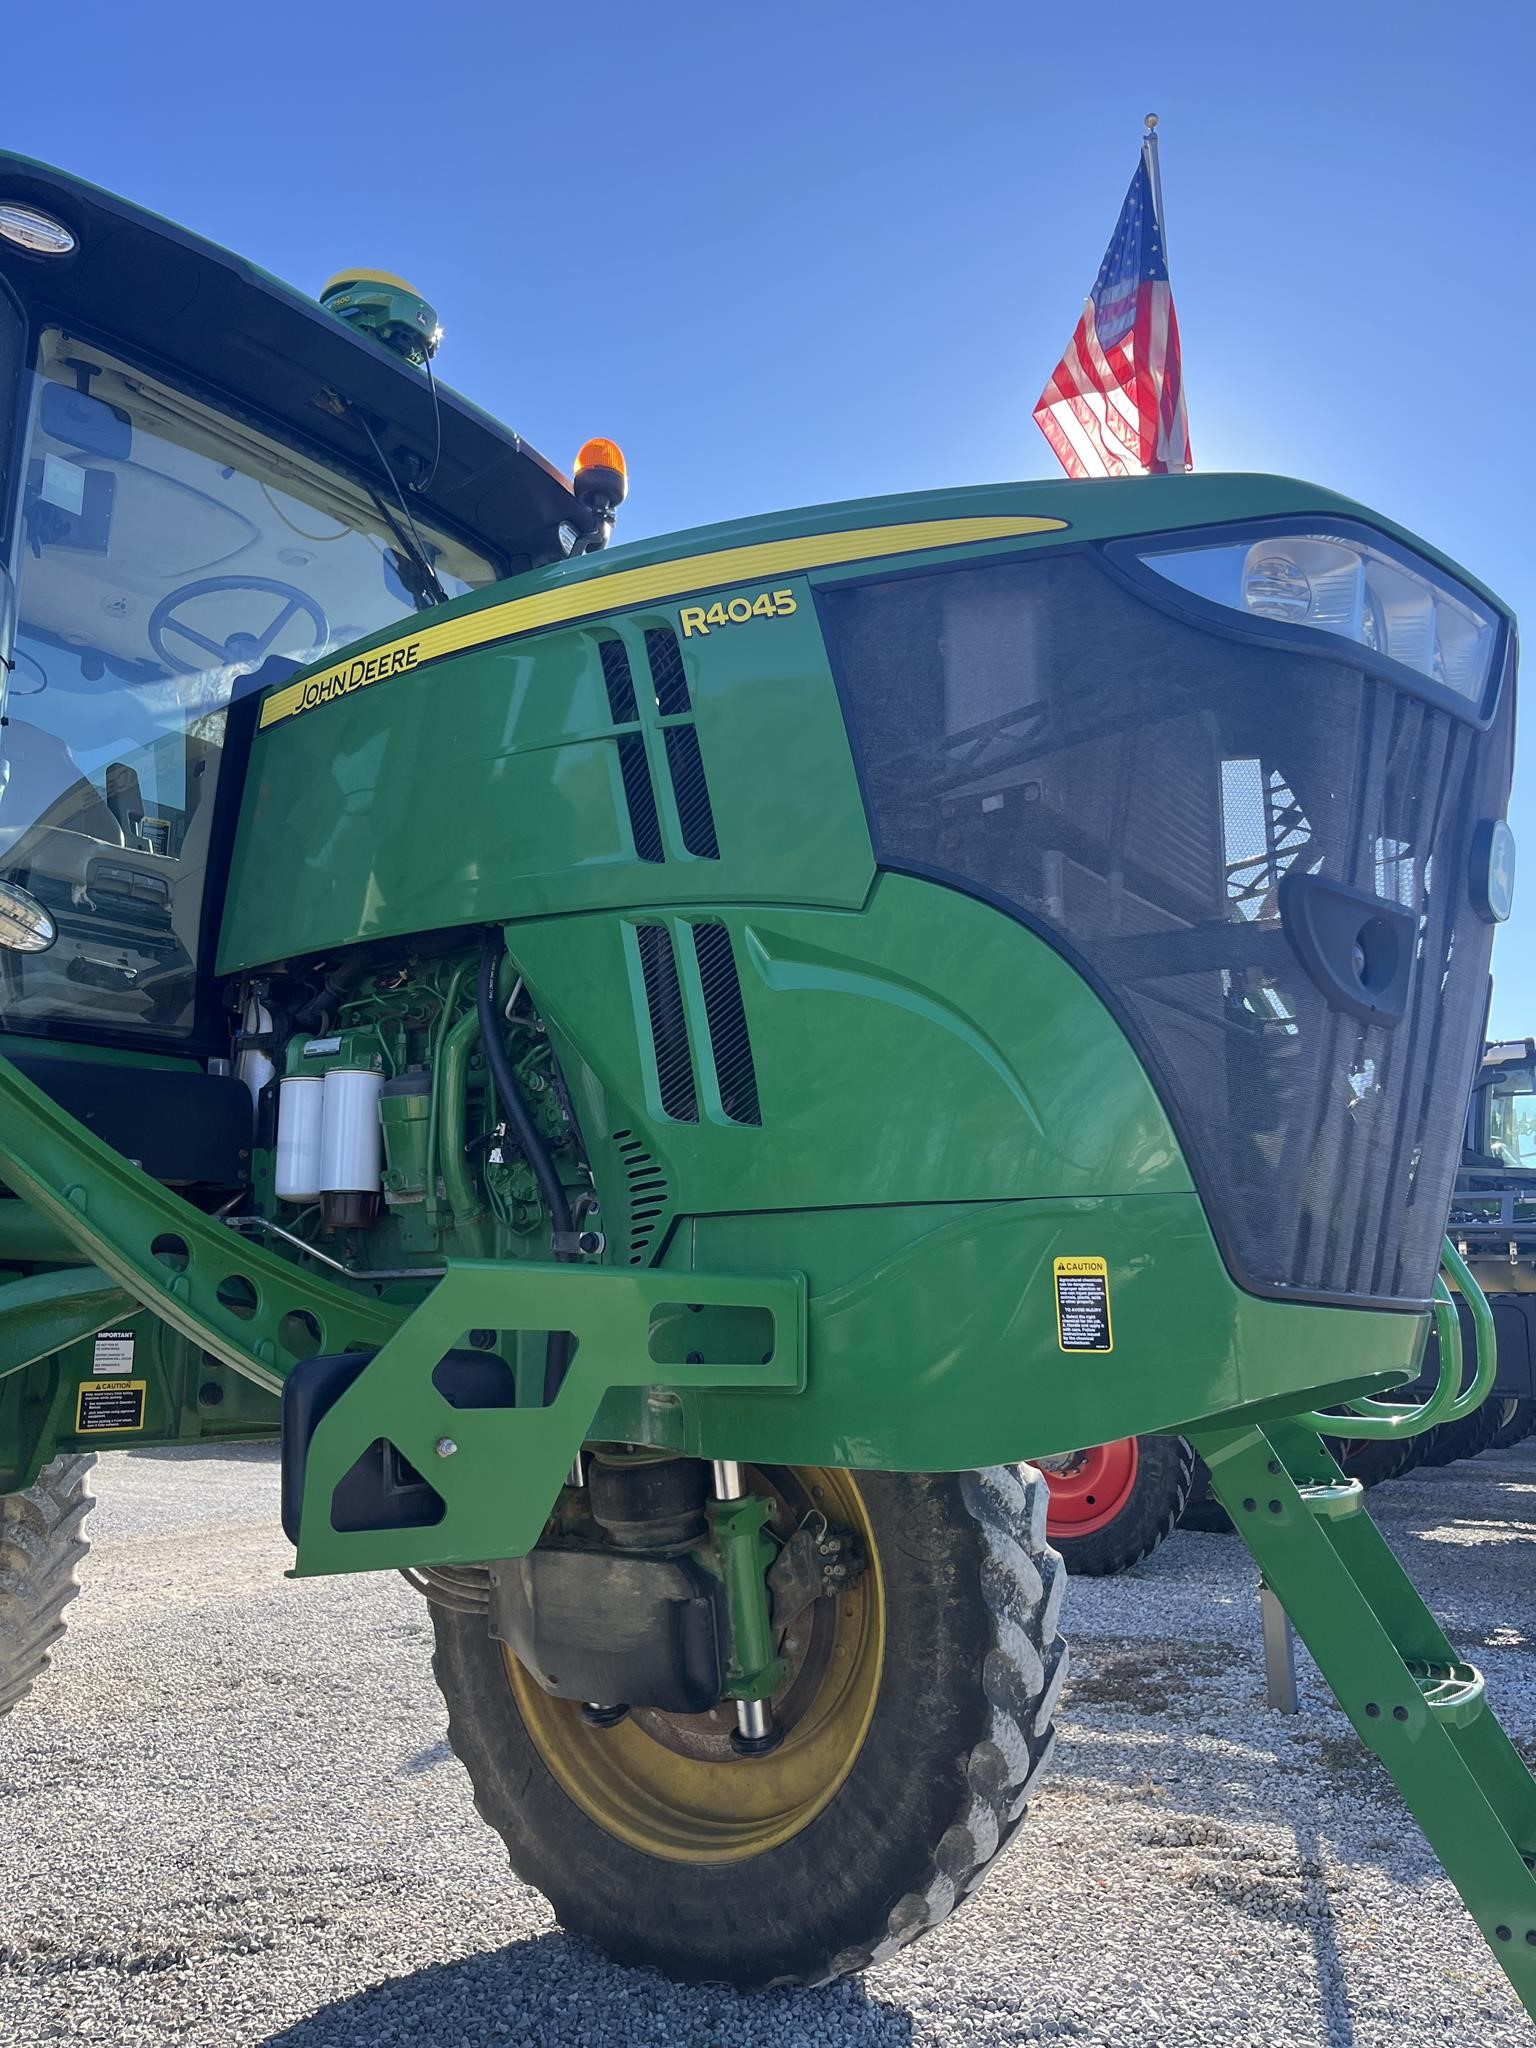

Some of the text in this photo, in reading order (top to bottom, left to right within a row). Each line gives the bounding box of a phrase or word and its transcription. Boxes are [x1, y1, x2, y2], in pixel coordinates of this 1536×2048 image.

[680, 589, 797, 637] R4045
[294, 642, 420, 711] JOHN DEERE
[1066, 1262, 1103, 1271] CAUTION
